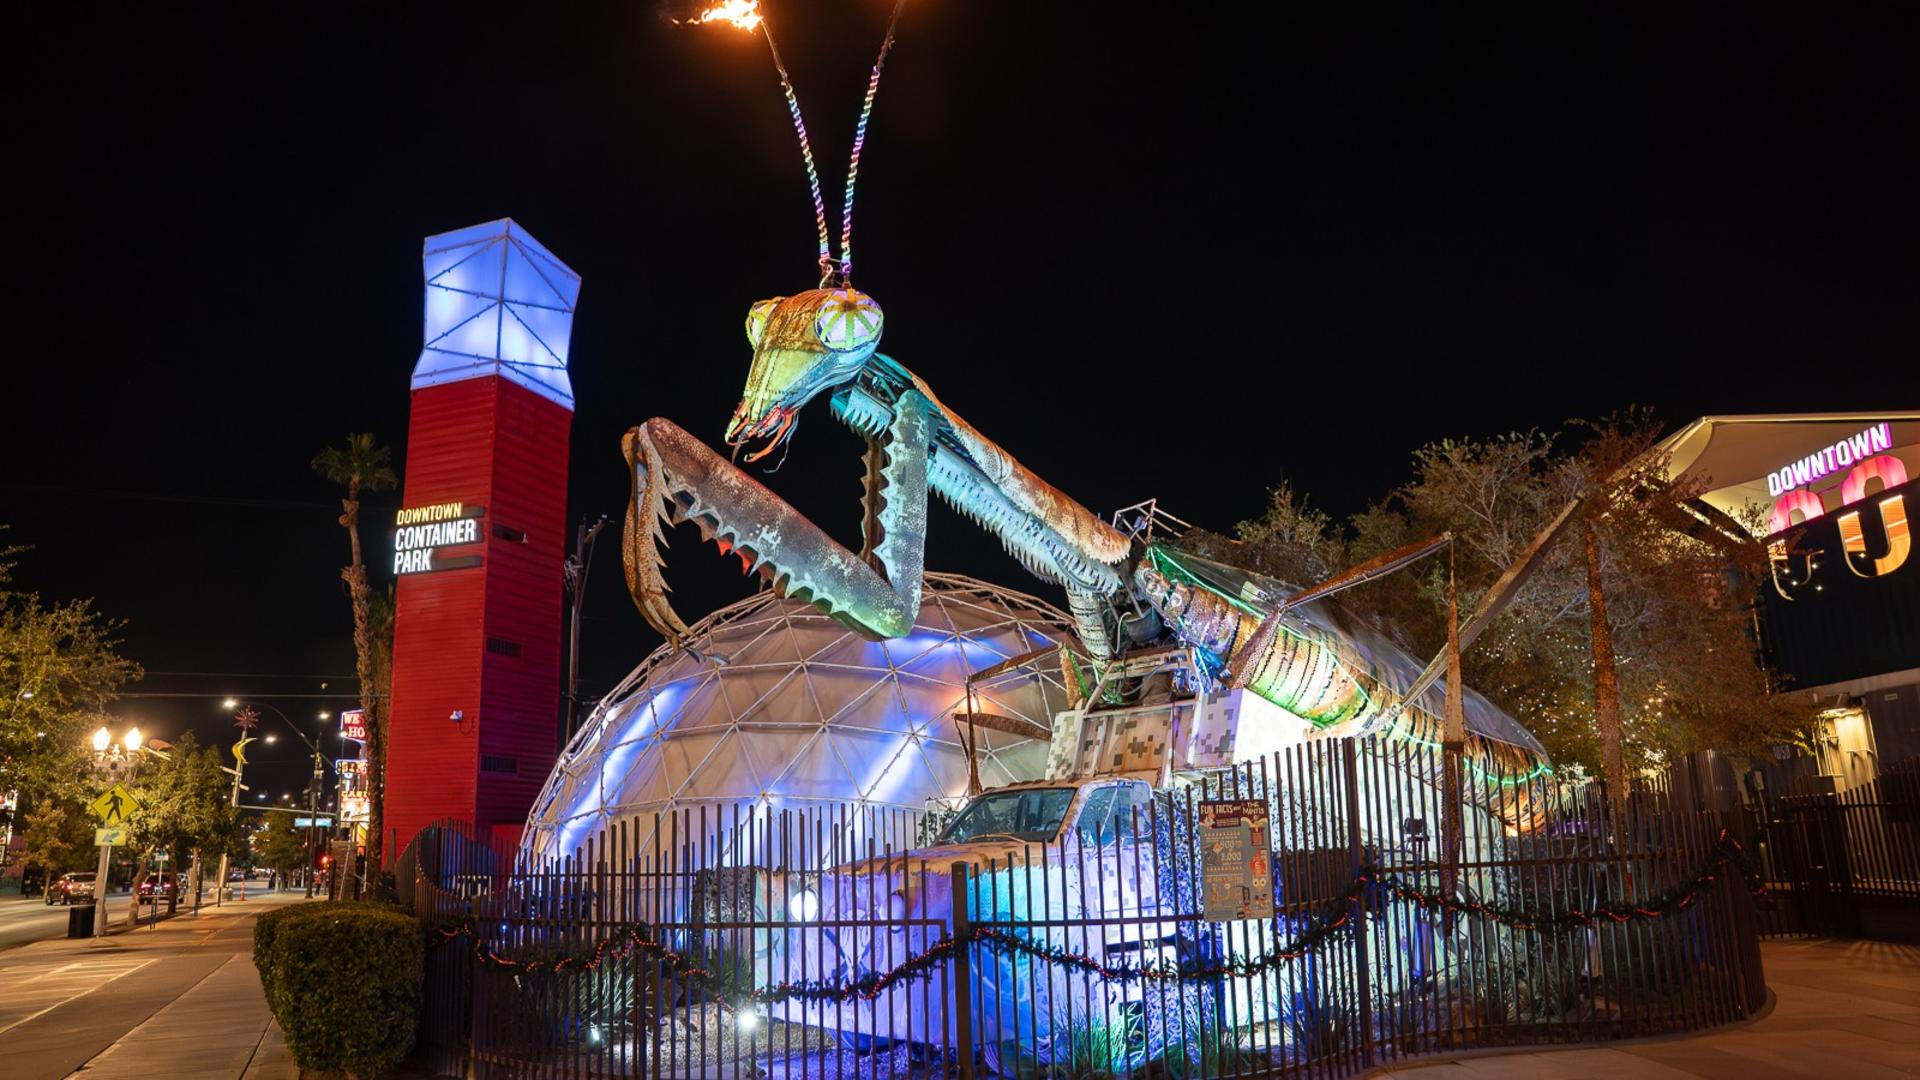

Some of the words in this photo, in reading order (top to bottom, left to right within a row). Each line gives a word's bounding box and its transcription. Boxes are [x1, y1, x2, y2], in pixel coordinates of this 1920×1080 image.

[1767, 422, 1893, 497] DOWNTOWN
[396, 502, 462, 525] DOWNTOWN
[395, 519, 476, 551] CONTAINER
[393, 548, 433, 574] PARK
